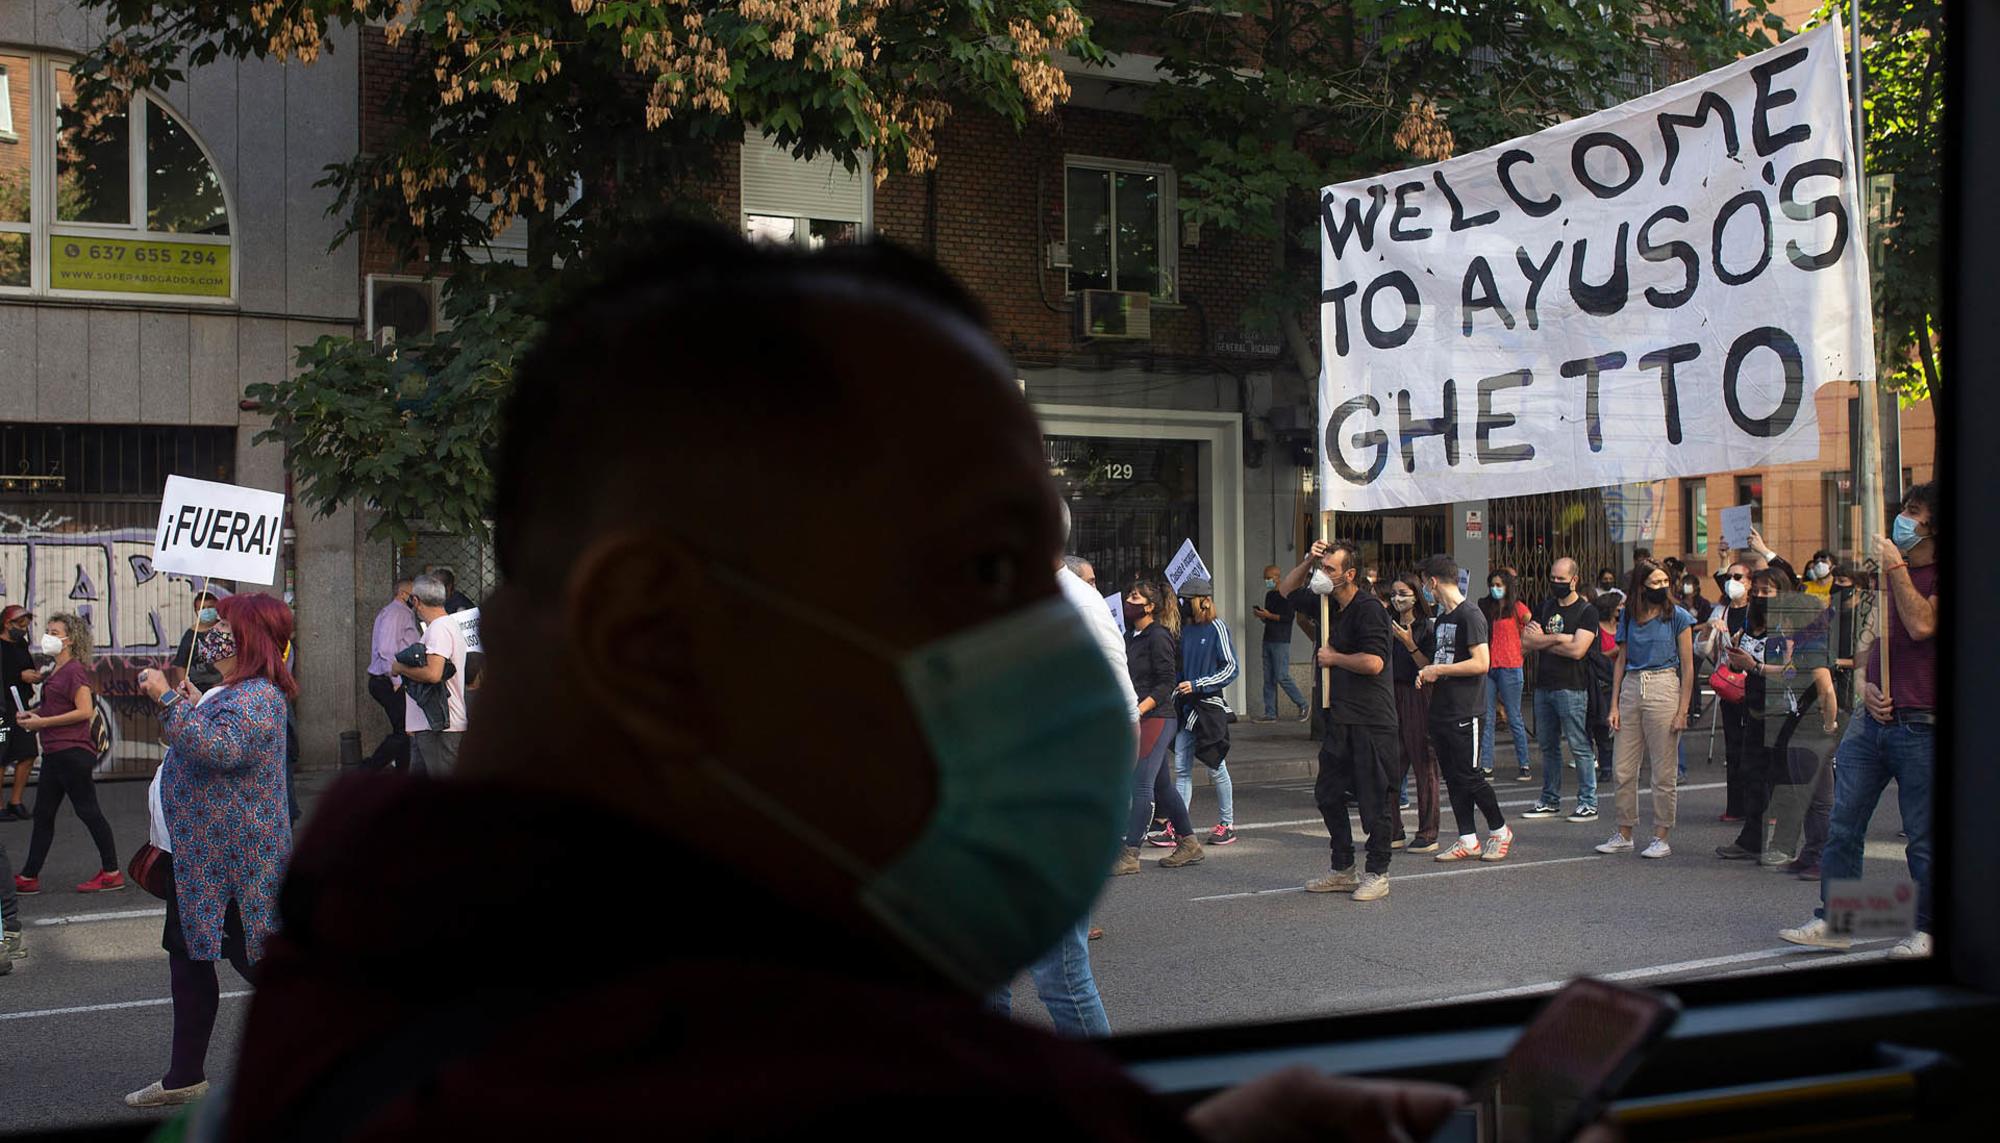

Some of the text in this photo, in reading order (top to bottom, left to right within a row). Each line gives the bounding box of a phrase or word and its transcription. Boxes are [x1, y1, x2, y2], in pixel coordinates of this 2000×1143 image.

[1323, 47, 1811, 260] WELCOME
[60, 270, 224, 286] WWW.SOFERABOGADOS.COM
[89, 244, 217, 265] 637 655 294
[1321, 158, 1849, 357] TO AYUSO'S
[1325, 325, 1804, 486] GHETTO
[1104, 463, 1133, 479] 129
[161, 504, 279, 556] ¡FUERA!
